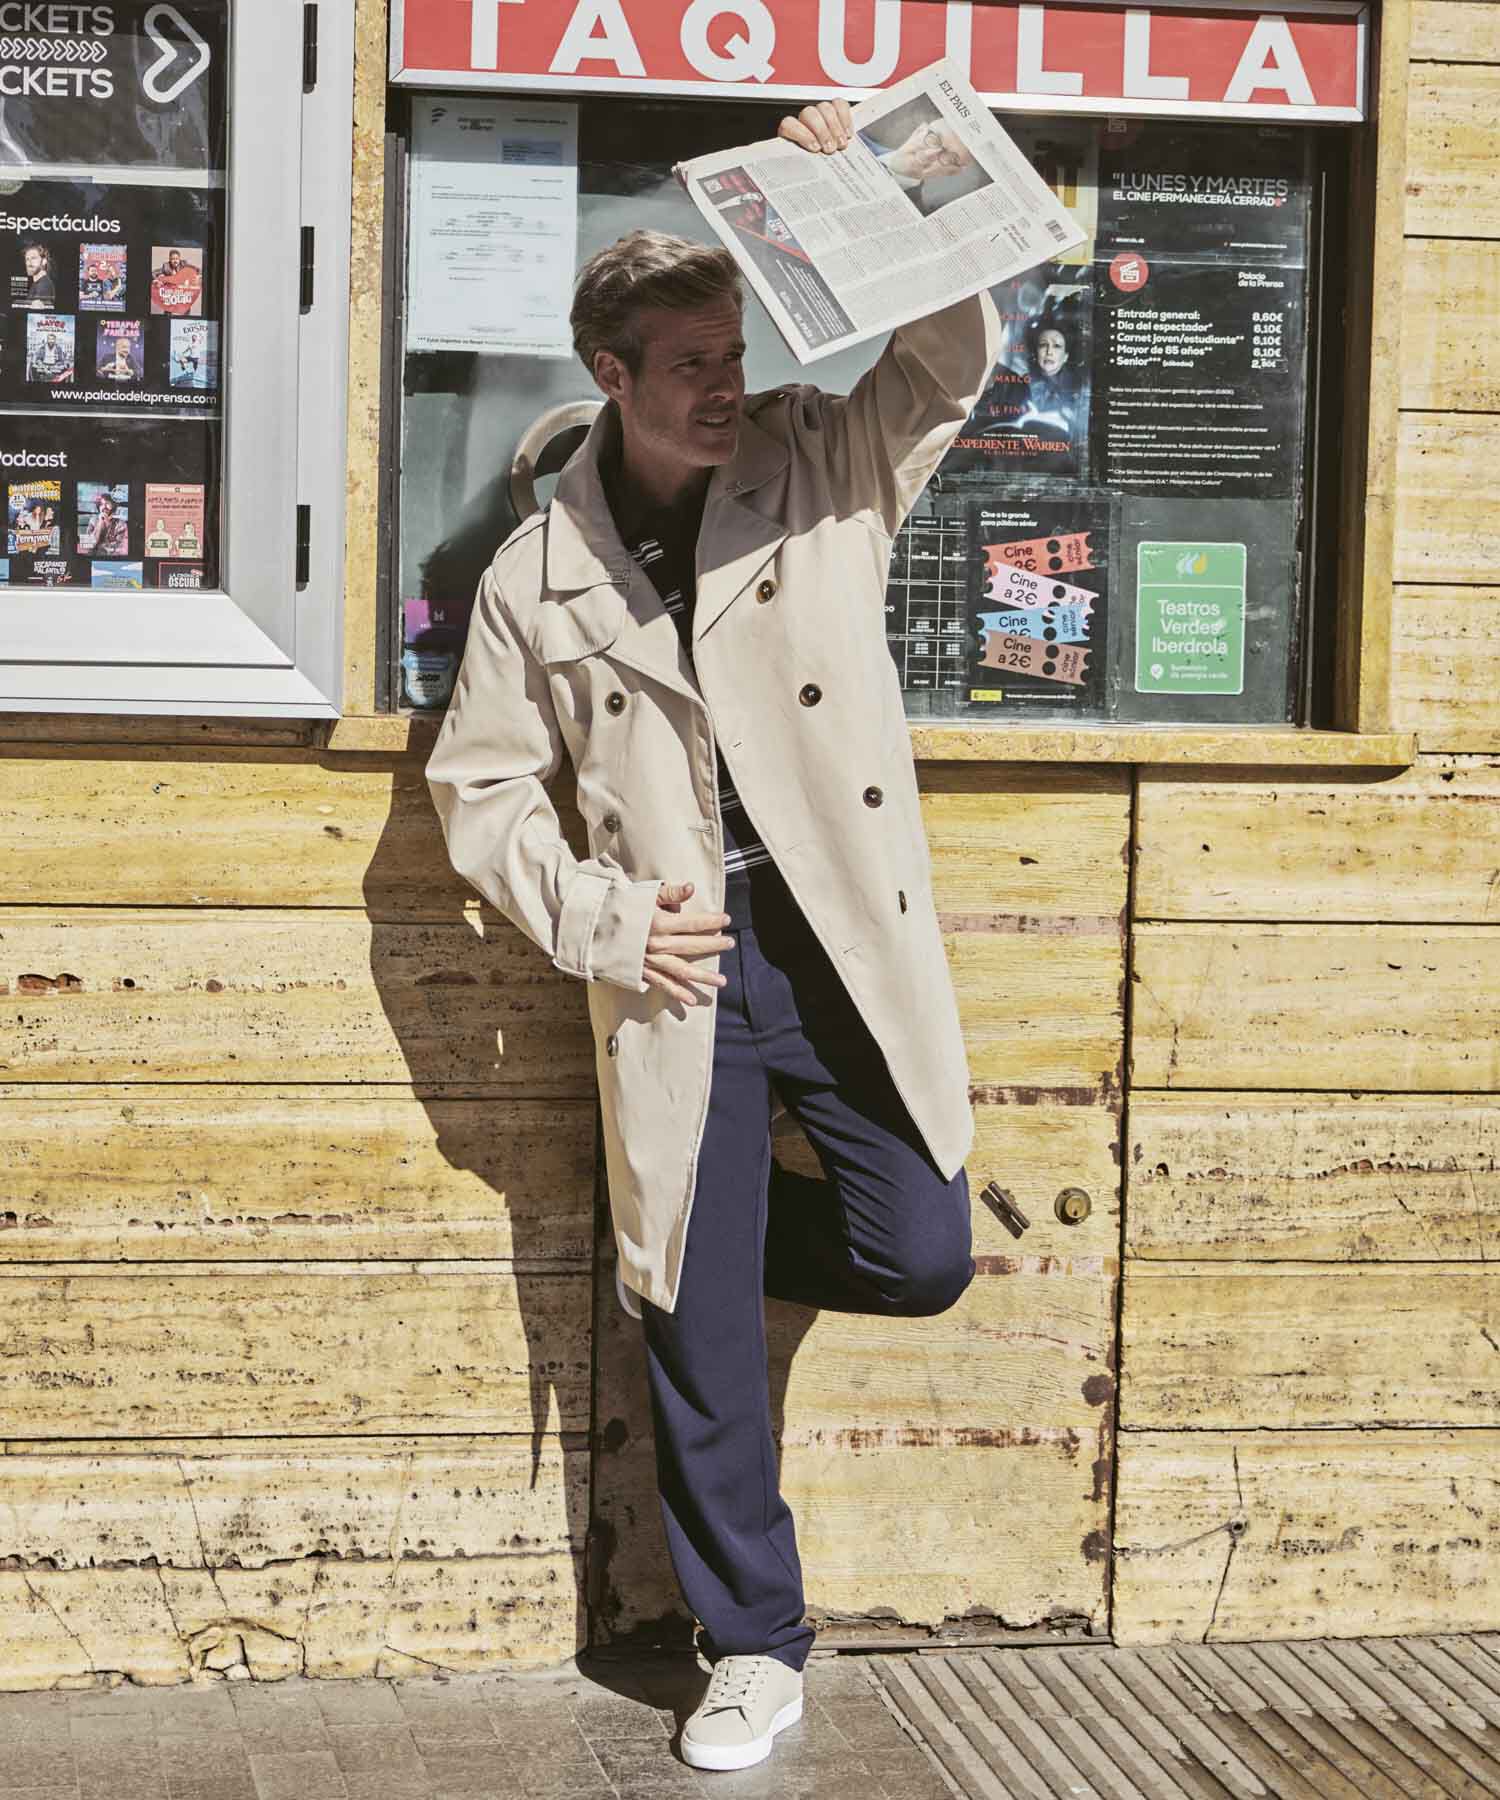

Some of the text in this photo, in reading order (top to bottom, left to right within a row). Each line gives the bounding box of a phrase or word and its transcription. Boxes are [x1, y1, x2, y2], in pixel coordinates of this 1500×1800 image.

[471, 0, 1318, 106] TAQUILLA
[1189, 175, 1205, 193] Y
[1206, 176, 1289, 197] MARTES
[1112, 191, 1126, 201] EL
[1127, 191, 1152, 202] CINE
[1152, 192, 1232, 205] PERMANECERÁ
[0, 211, 121, 235] Espectáculos
[1238, 271, 1266, 281] Palacio
[1117, 309, 1159, 318] Entrada
[1160, 310, 1201, 322] general:
[1117, 321, 1135, 330] Día
[1136, 321, 1152, 331] del
[1117, 332, 1152, 342] Carnet
[1117, 344, 1149, 356] Mayor
[1150, 346, 1164, 355] de
[51, 389, 217, 405] www.palaciodelaprensa.com
[952, 438, 1073, 453] EXPEDIENTE WARREN
[1004, 546, 1033, 558] Cine
[1010, 572, 1038, 589] Cine
[1004, 589, 1038, 606] a 2€
[1156, 600, 1220, 616] Teatros
[999, 616, 1028, 628] Cine
[1161, 618, 1220, 635] Verdes
[1003, 638, 1032, 653] Cine
[1152, 635, 1228, 654] Iberdrola
[998, 653, 1032, 668] a 2€
